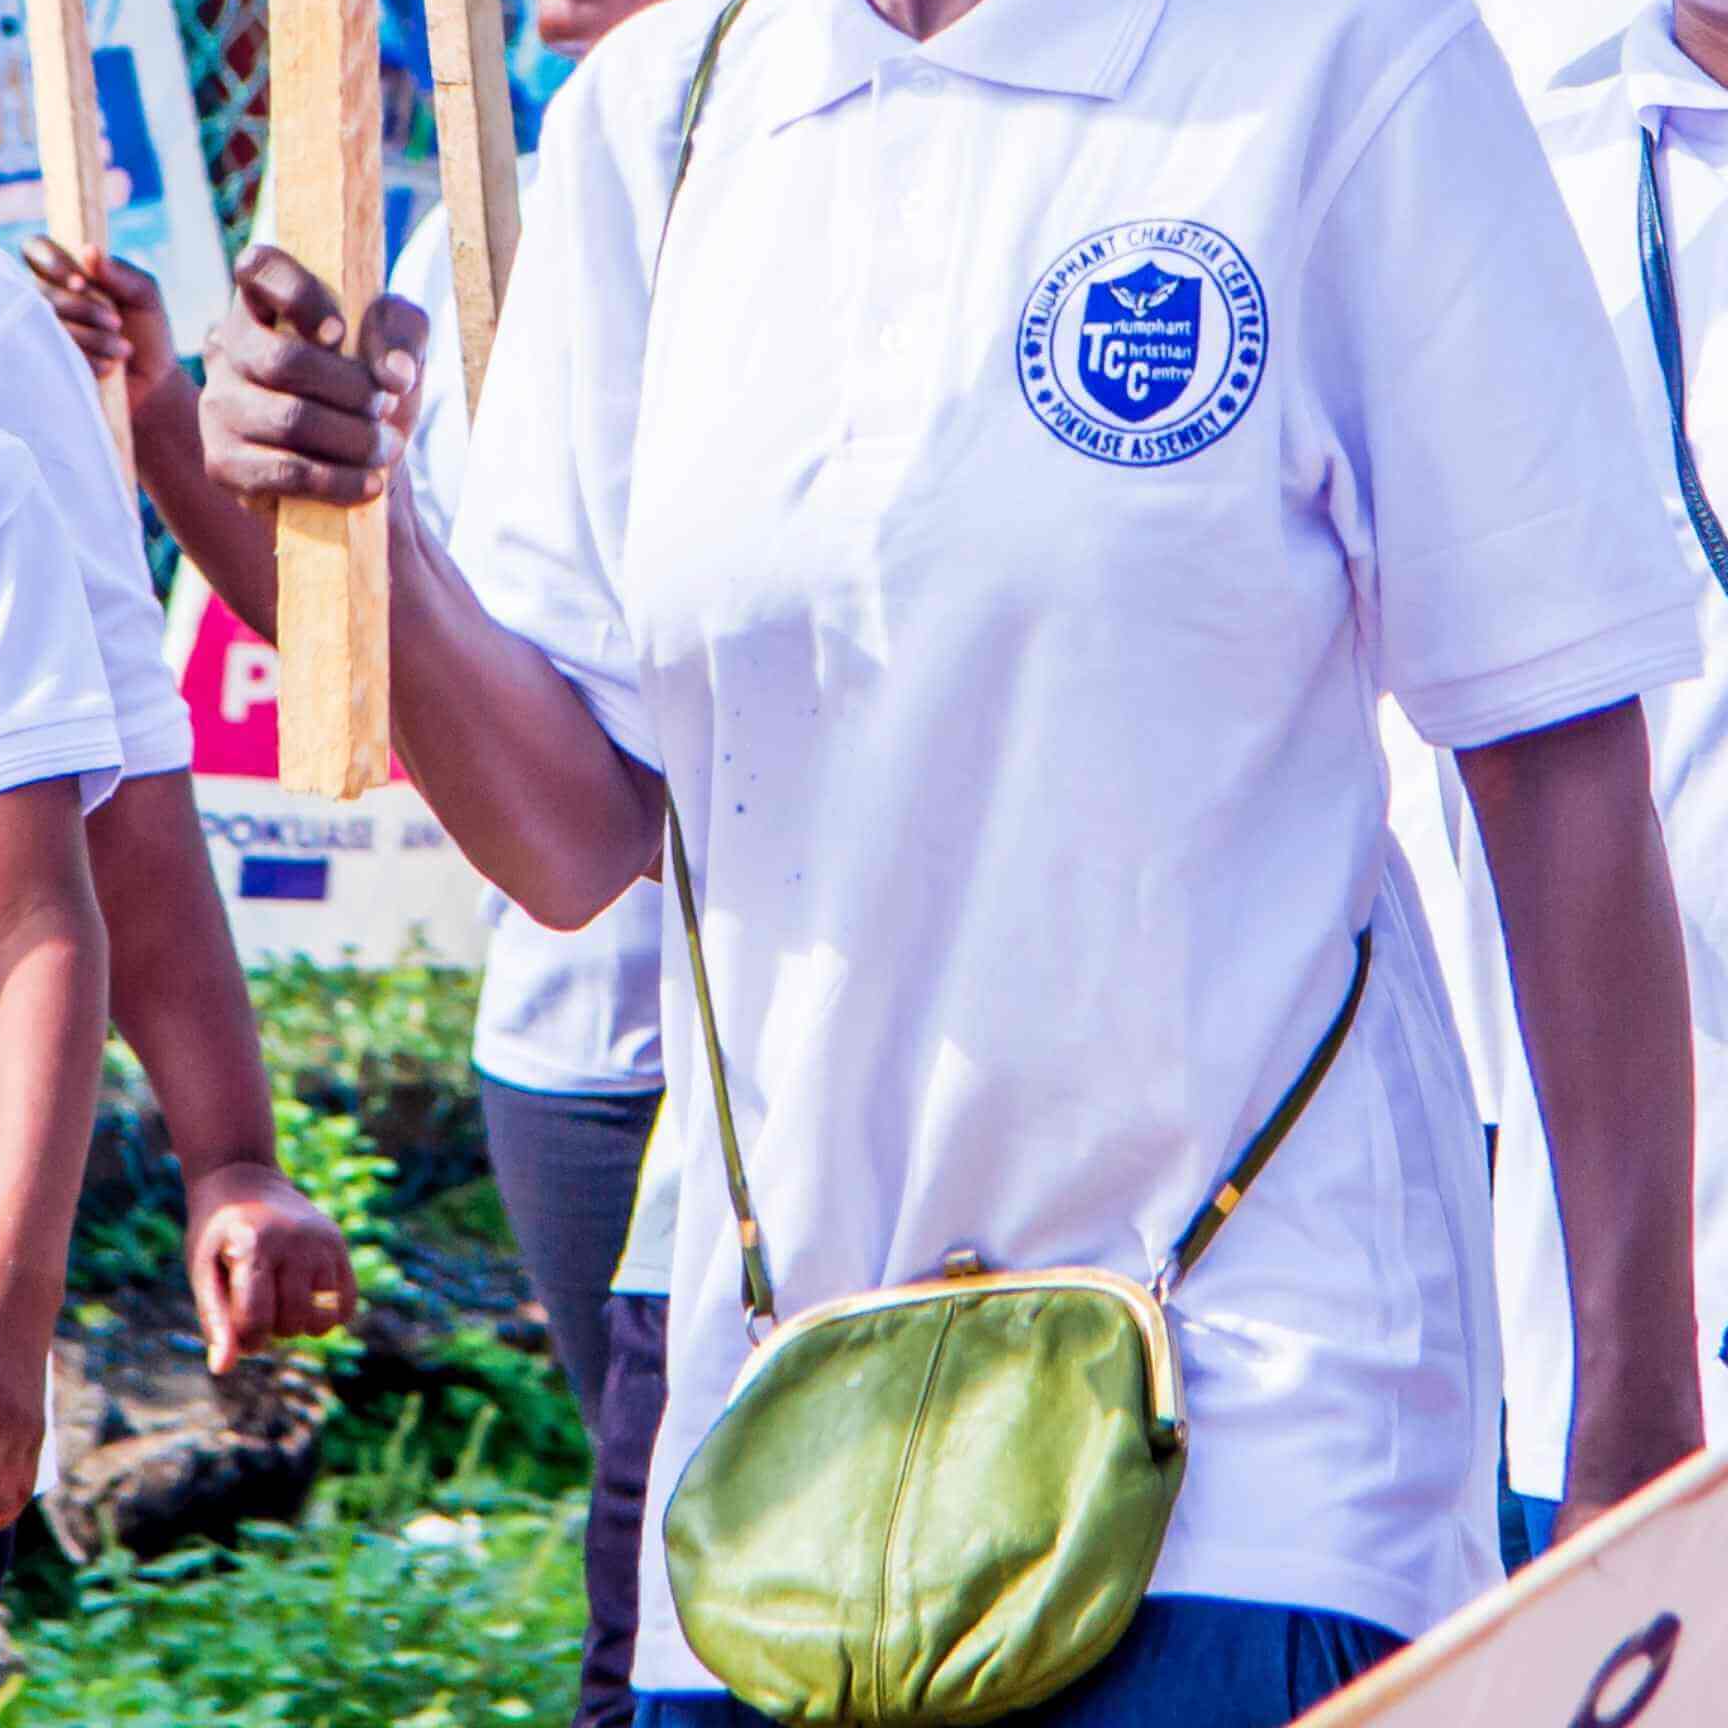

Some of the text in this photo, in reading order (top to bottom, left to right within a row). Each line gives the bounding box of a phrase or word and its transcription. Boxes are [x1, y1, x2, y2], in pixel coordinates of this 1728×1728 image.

[1026, 236, 1117, 339] TRIUMPHANT
[1127, 225, 1223, 263] CHRISTIAN
[1046, 401, 1222, 461] POKUASE ASSEMBLY
